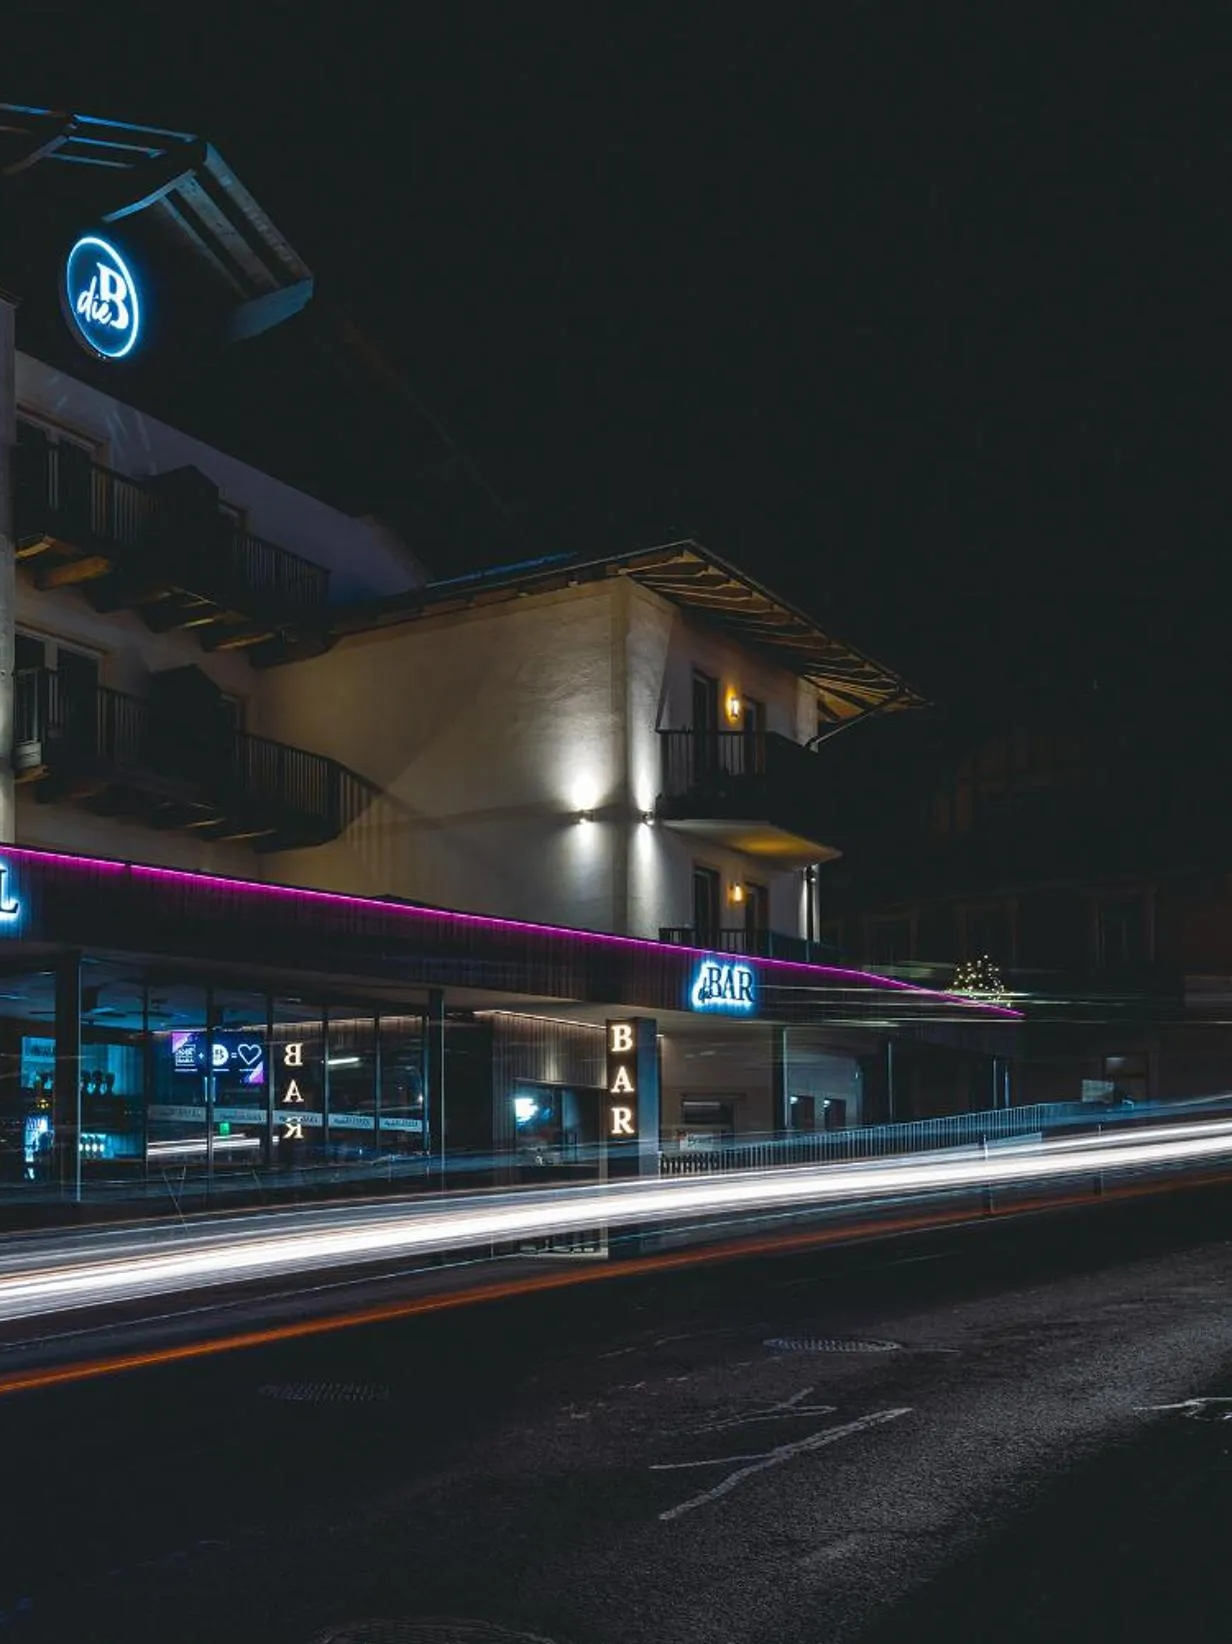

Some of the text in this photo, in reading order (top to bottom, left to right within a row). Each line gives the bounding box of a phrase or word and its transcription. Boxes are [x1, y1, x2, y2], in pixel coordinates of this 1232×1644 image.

[76, 261, 130, 330] die B
[706, 966, 755, 1002] BAR
[610, 1023, 636, 1135] BAR
